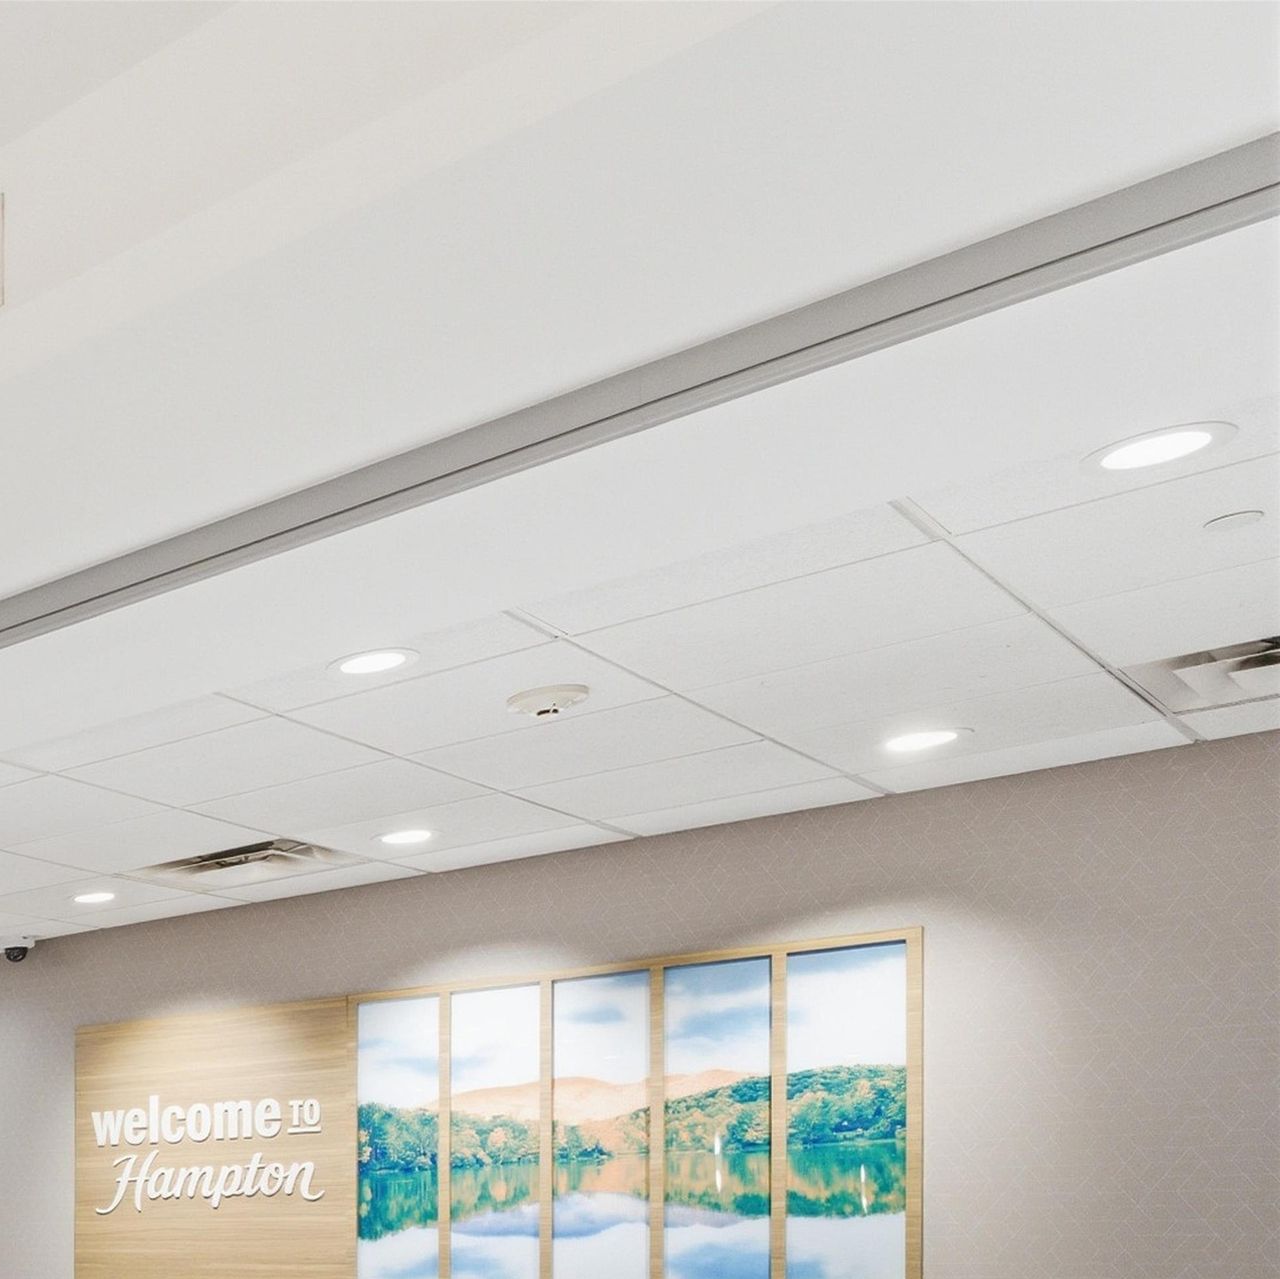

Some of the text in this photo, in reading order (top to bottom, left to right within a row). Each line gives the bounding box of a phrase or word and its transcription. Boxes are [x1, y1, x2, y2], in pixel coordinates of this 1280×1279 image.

[91, 1094, 322, 1147] welcome TO
[95, 1149, 326, 1215] Hampton
